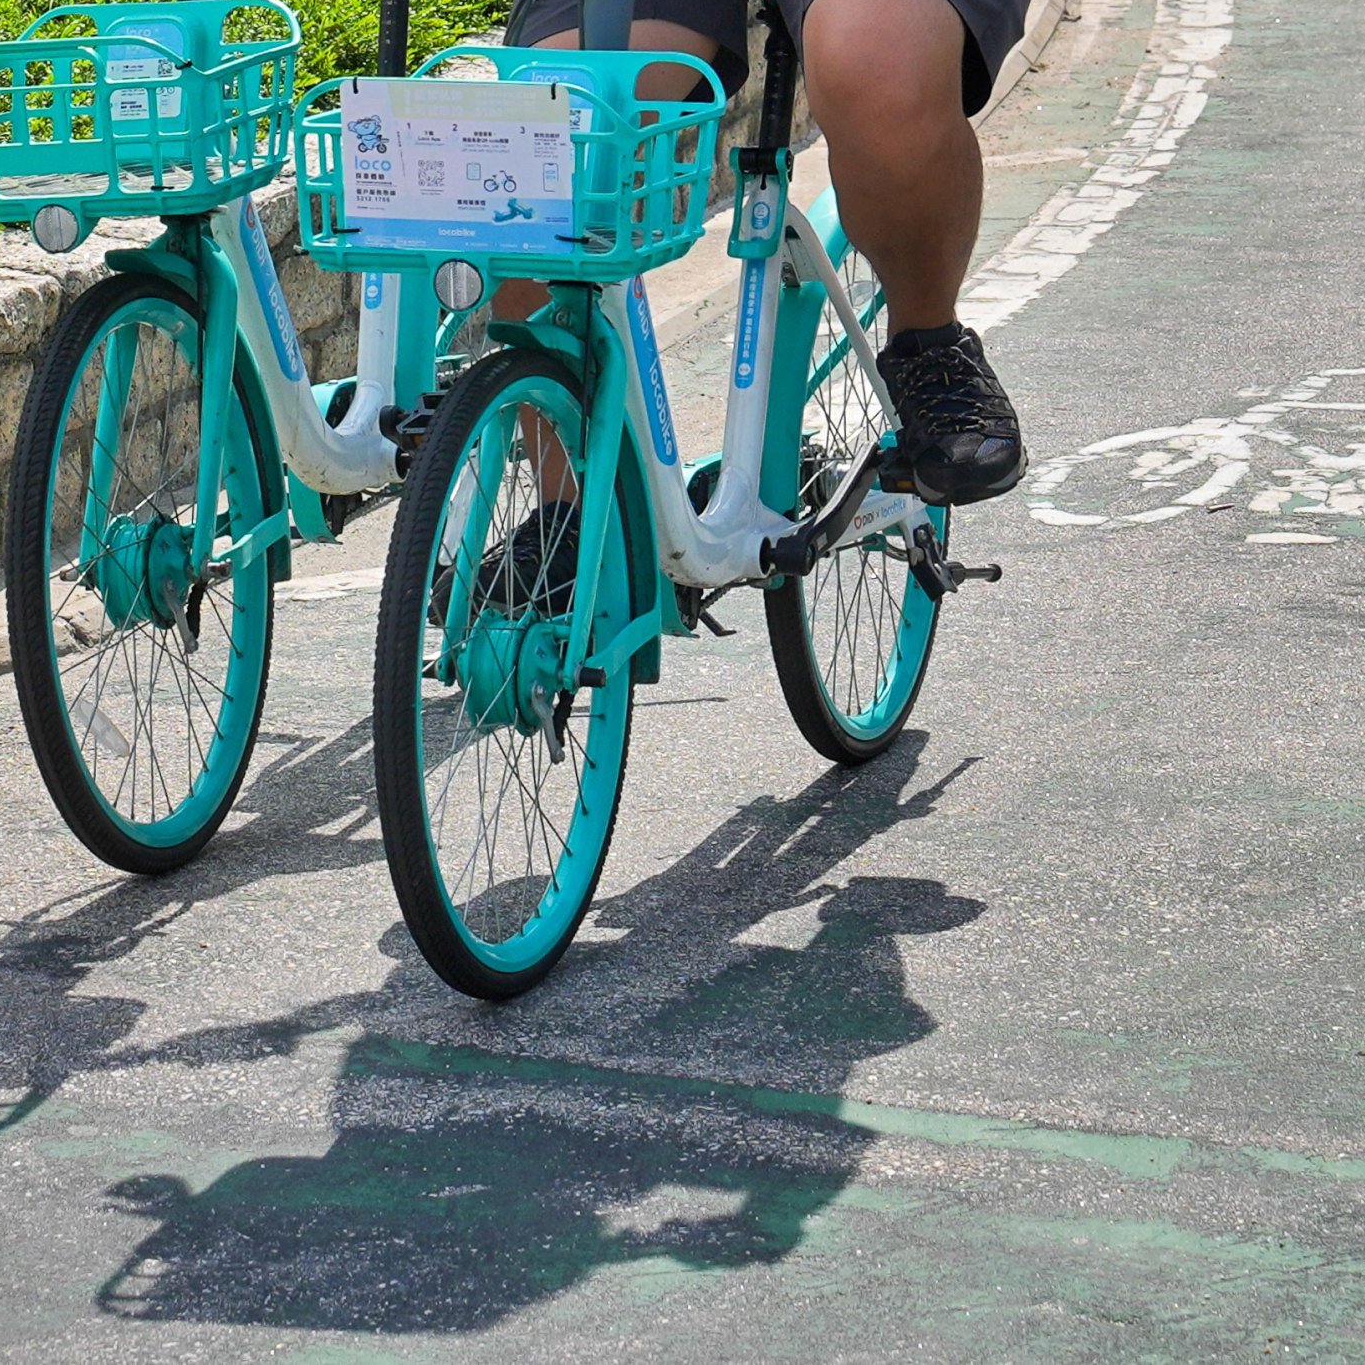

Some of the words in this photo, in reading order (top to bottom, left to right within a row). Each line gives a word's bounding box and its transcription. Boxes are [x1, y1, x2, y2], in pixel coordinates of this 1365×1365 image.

[452, 123, 458, 132] 2
[354, 155, 392, 172] loco
[438, 227, 476, 237] locobike
[268, 282, 298, 373] locobike
[649, 357, 672, 457] locobike
